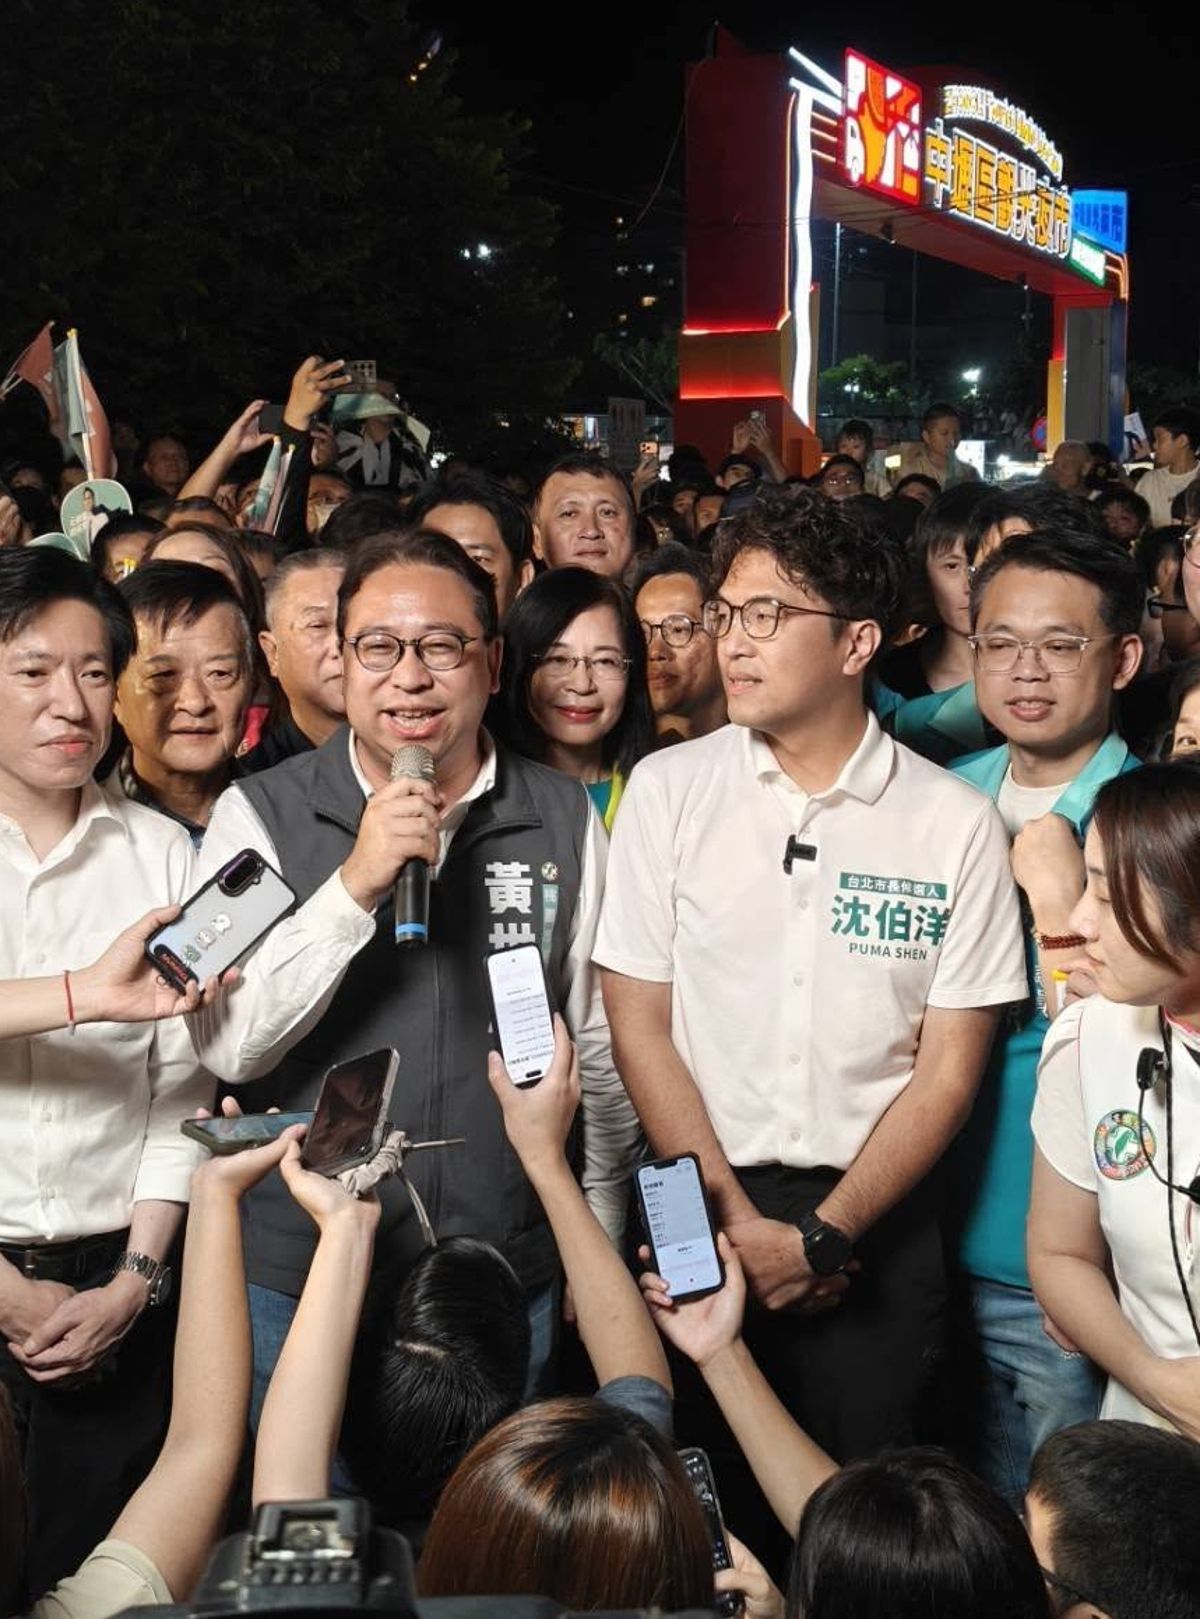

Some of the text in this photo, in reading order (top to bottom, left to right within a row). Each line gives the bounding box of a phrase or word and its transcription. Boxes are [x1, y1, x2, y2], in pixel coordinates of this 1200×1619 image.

[847, 875, 940, 898] 台北市長候選人
[831, 894, 950, 946] 沈伯洋
[848, 942, 928, 960] PUMA SHEN
